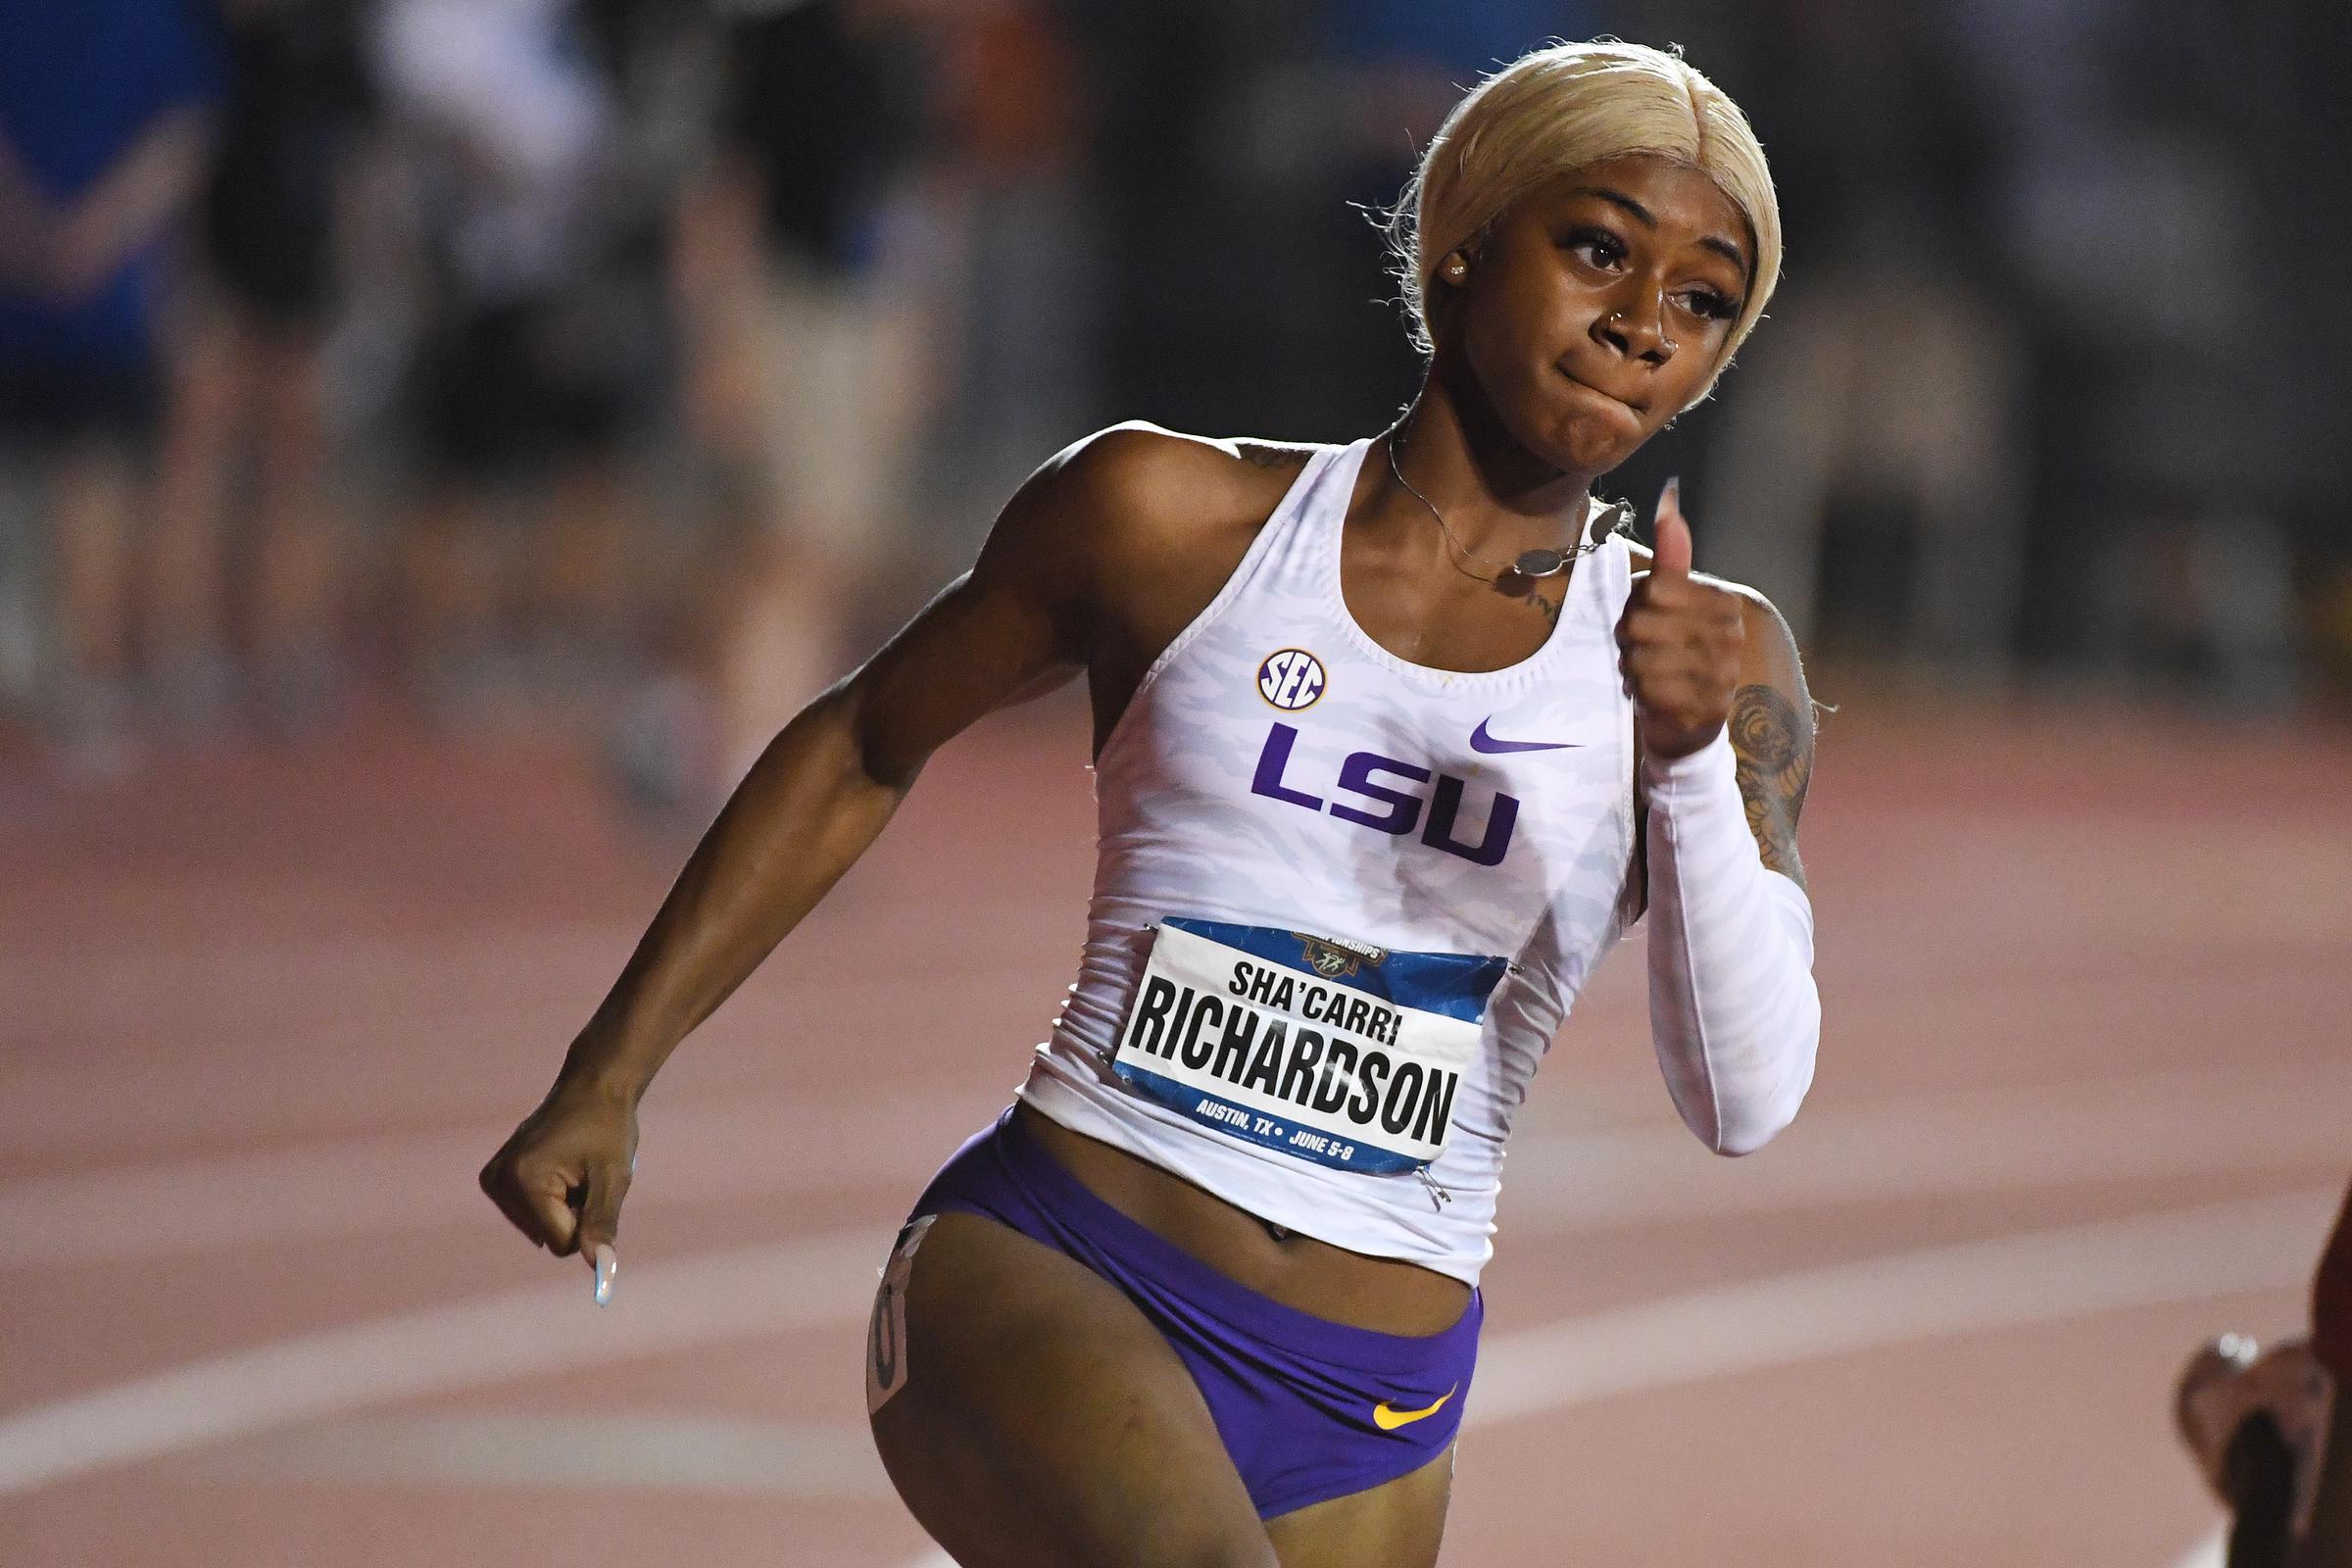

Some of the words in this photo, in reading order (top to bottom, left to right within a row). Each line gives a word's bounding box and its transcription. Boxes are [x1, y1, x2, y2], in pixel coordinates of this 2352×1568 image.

[1260, 651, 1326, 710] SEC
[1250, 721, 1520, 867] LSU
[1228, 960, 1403, 1047] SHA'CARRI
[1128, 974, 1459, 1148] RICHARDSON
[1196, 1099, 1250, 1130] AUSTIN,
[1289, 1130, 1329, 1153] JUNE
[1327, 1141, 1355, 1161] 5-8
